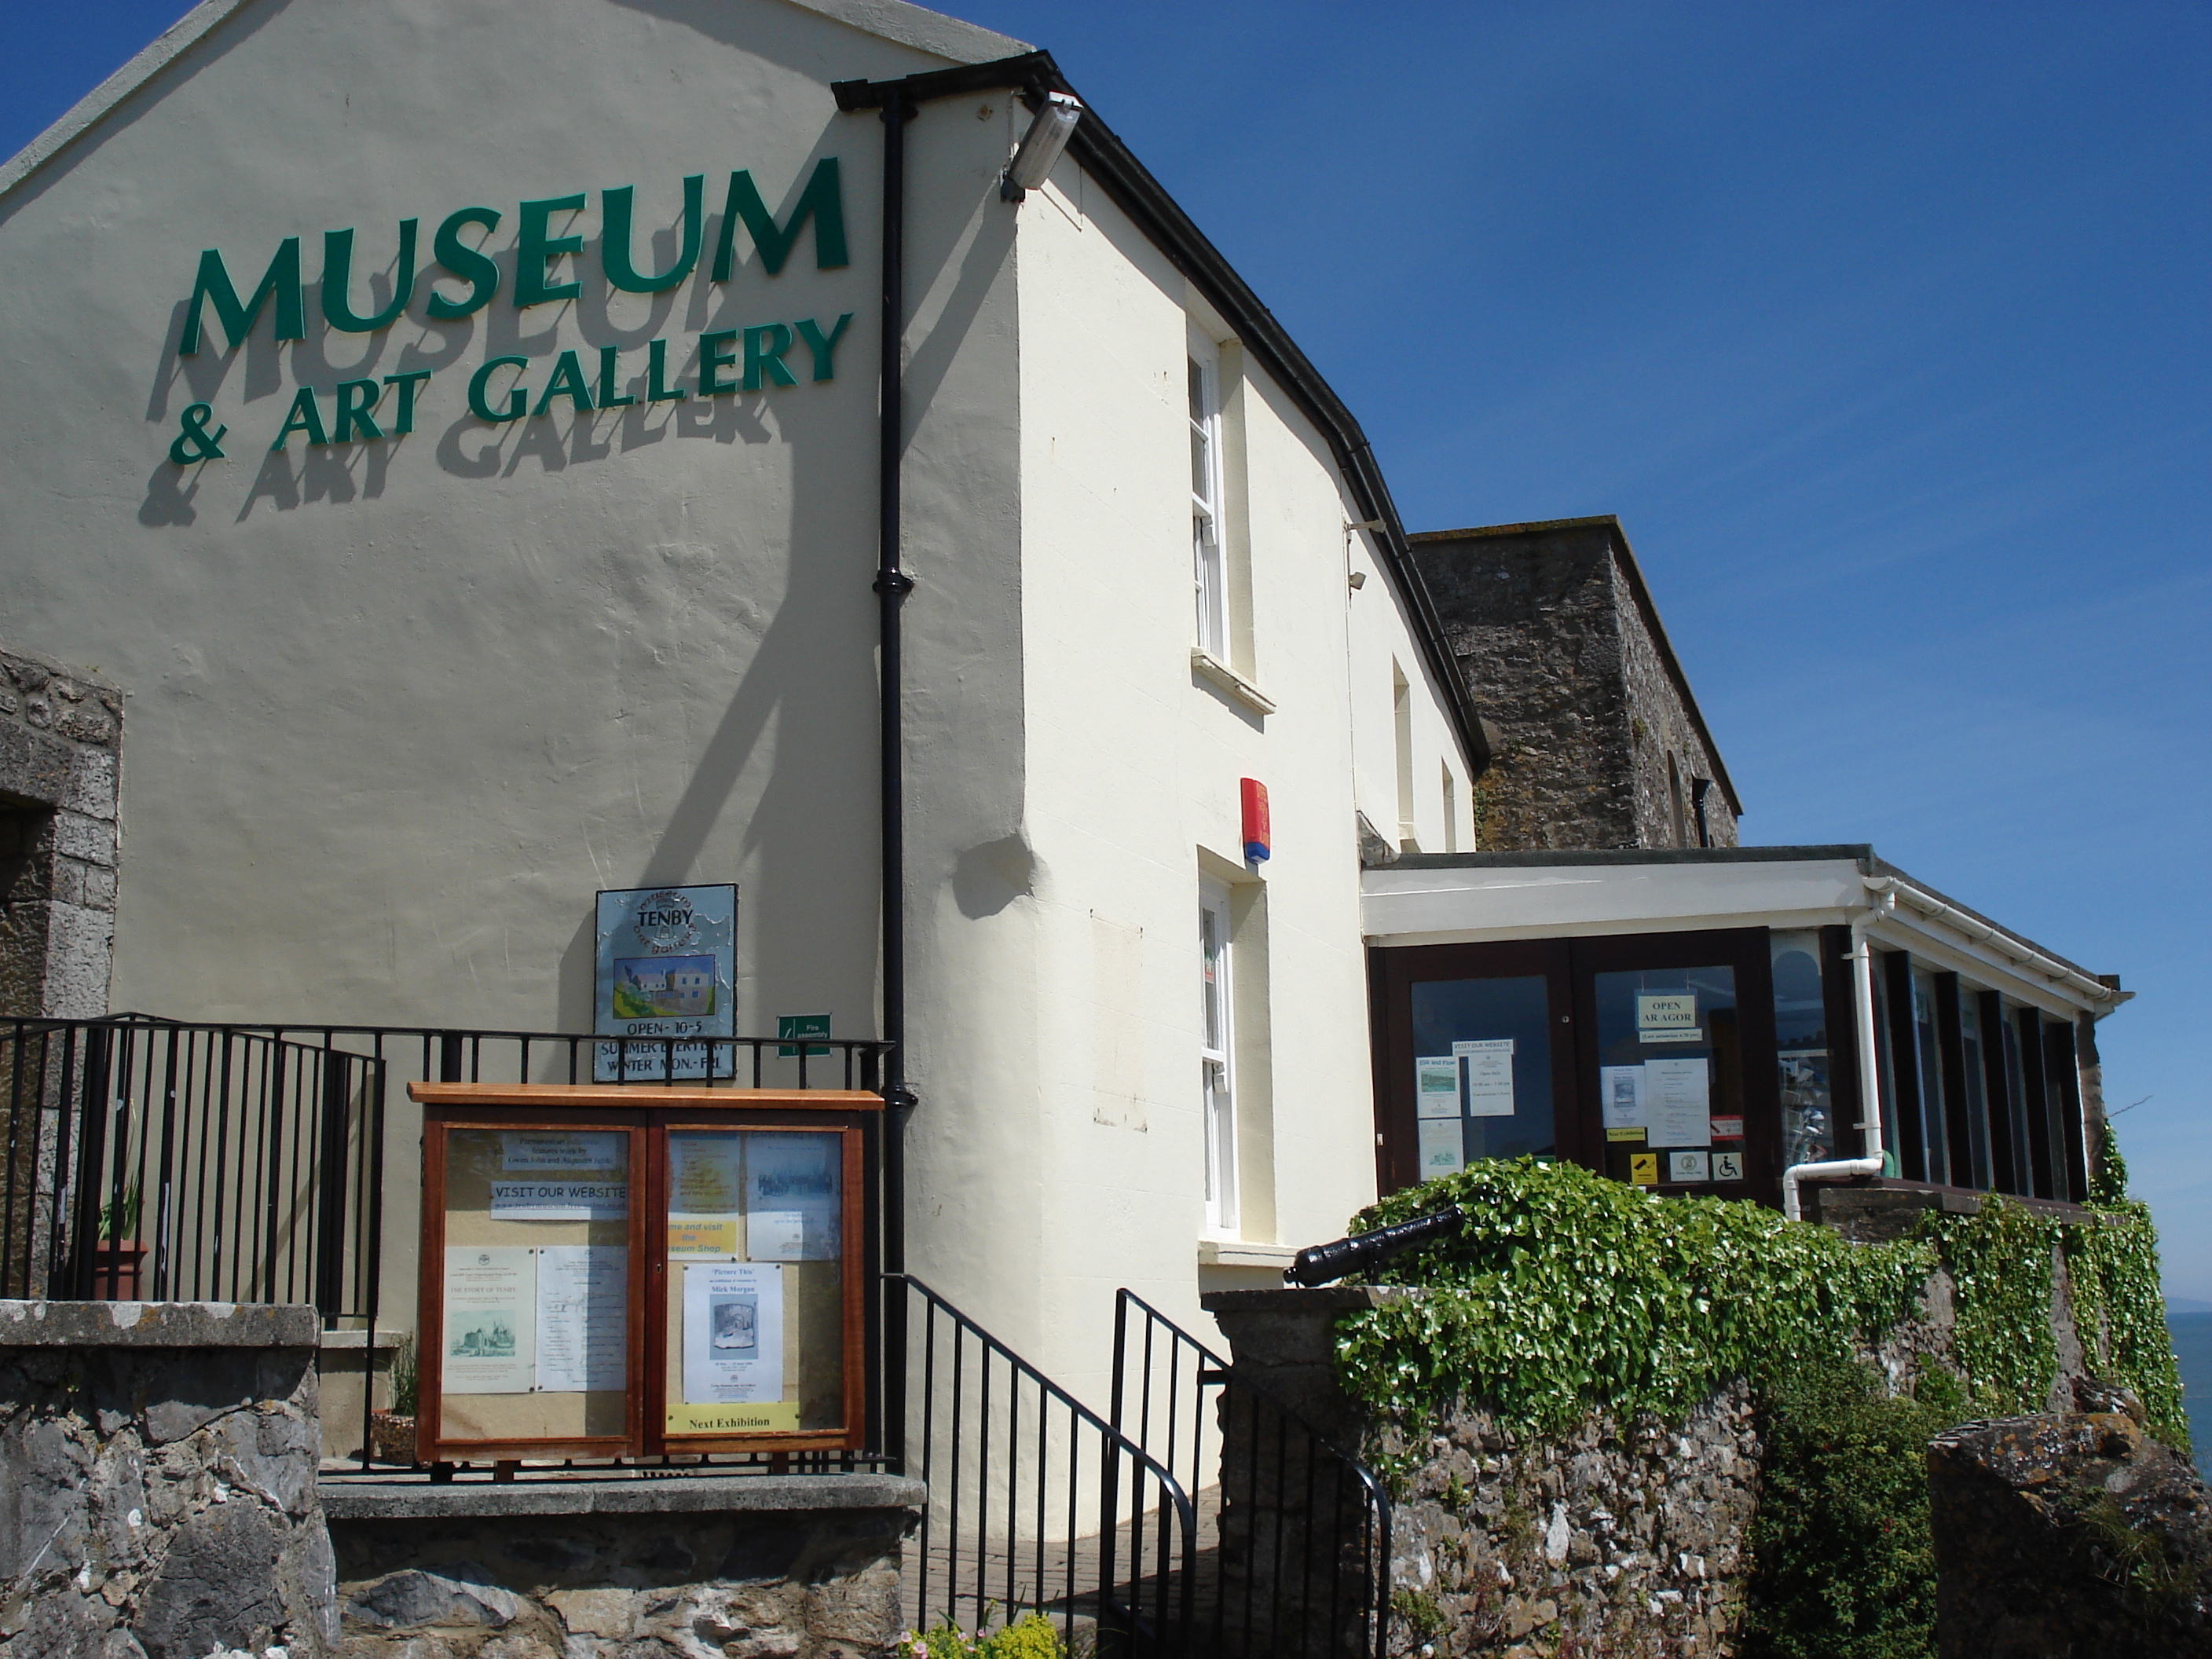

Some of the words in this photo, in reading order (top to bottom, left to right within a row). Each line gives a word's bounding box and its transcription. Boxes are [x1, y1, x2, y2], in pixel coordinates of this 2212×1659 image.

[179, 157, 850, 356] MUSEUM
[170, 401, 228, 466] &
[271, 368, 432, 452] ART
[467, 313, 854, 423] GALLERY
[637, 909, 694, 927] TENBY
[1643, 1013, 1658, 1022] AR
[676, 1021, 702, 1034] 10-5
[607, 1060, 652, 1071] WNTER
[496, 1187, 535, 1198] VISIT
[538, 1187, 565, 1198] OUR
[569, 1186, 626, 1198] WEBSITE
[684, 1222, 702, 1231] and
[704, 1222, 723, 1231] visit
[698, 1244, 721, 1254] Shop
[689, 1419, 713, 1429] Next
[716, 1417, 770, 1428] Exhibition
